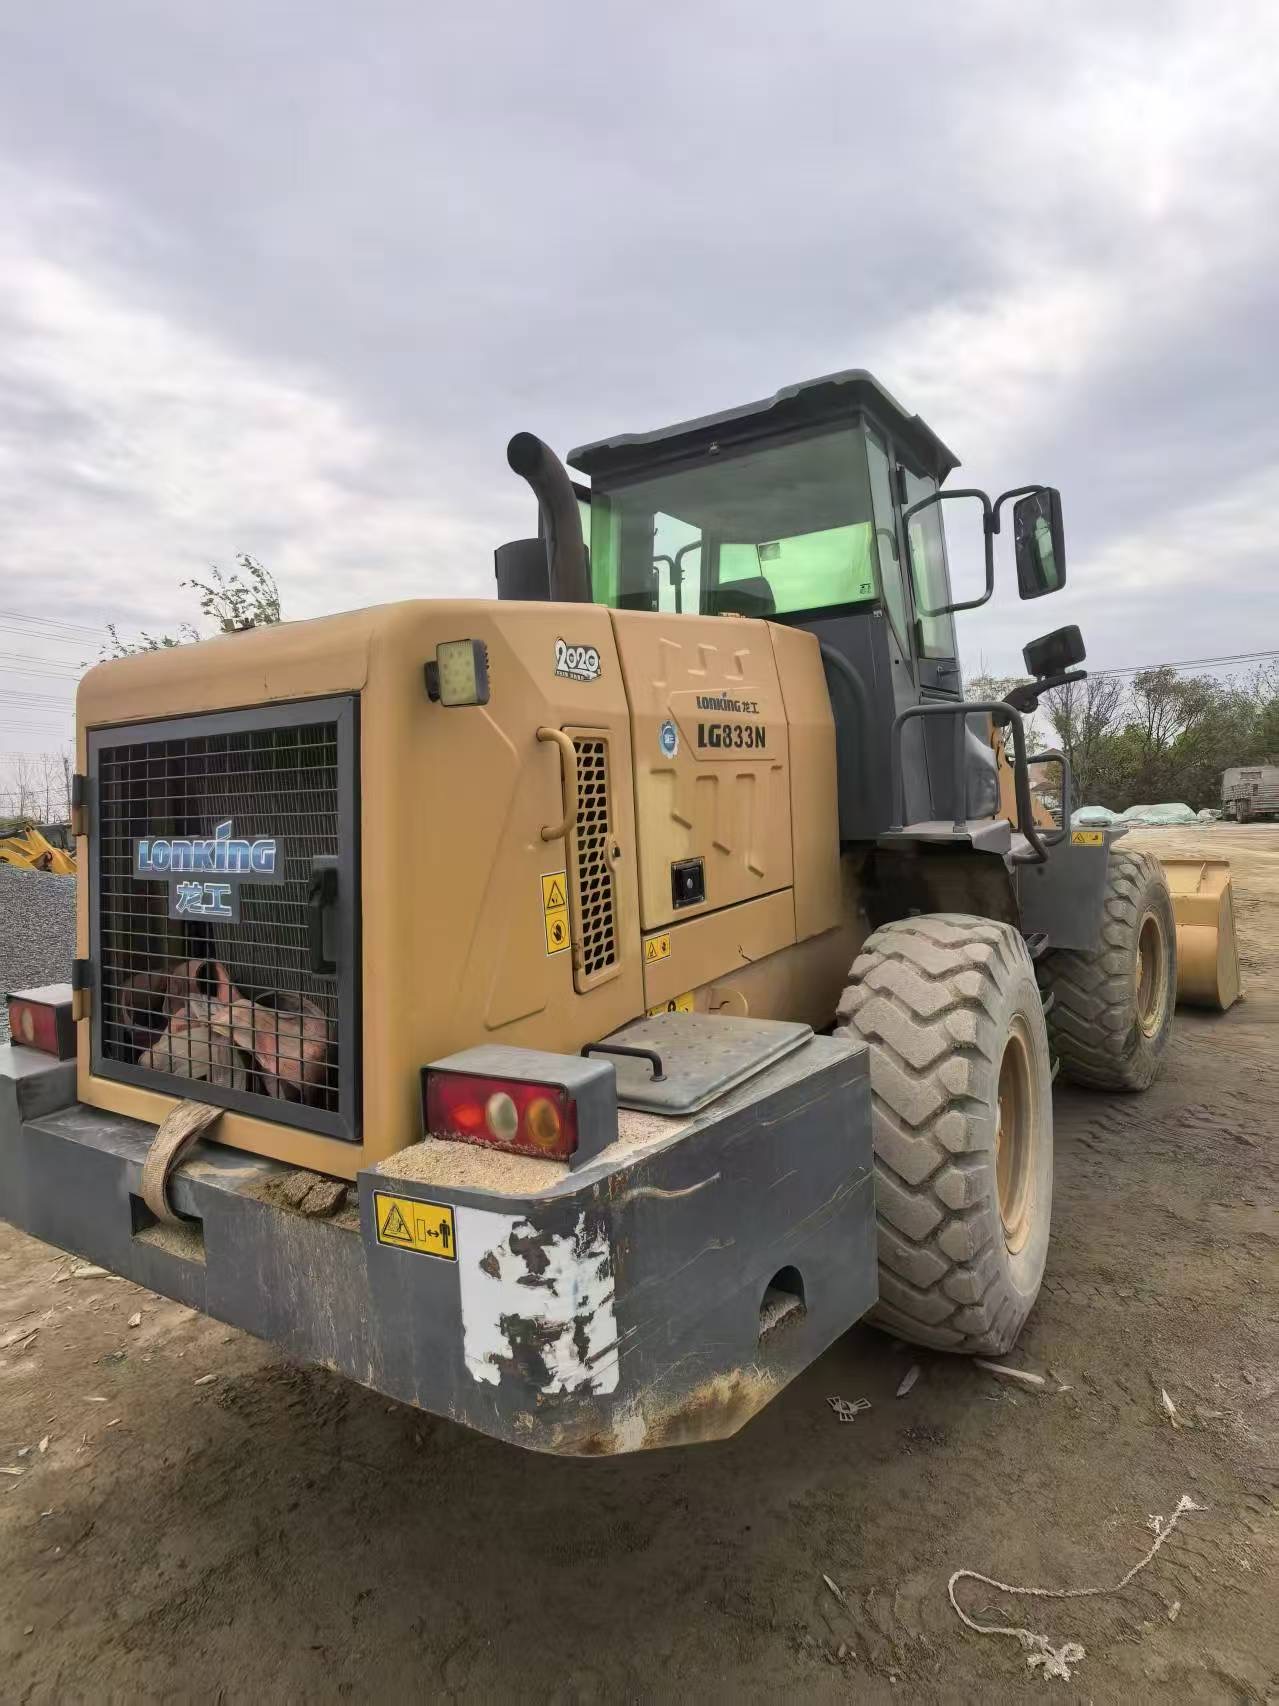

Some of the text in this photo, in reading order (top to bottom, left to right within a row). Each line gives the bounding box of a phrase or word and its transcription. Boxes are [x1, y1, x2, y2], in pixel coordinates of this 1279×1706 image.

[555, 639, 599, 672] 2020
[697, 723, 766, 748] LG833N
[176, 881, 232, 916] 龙工
